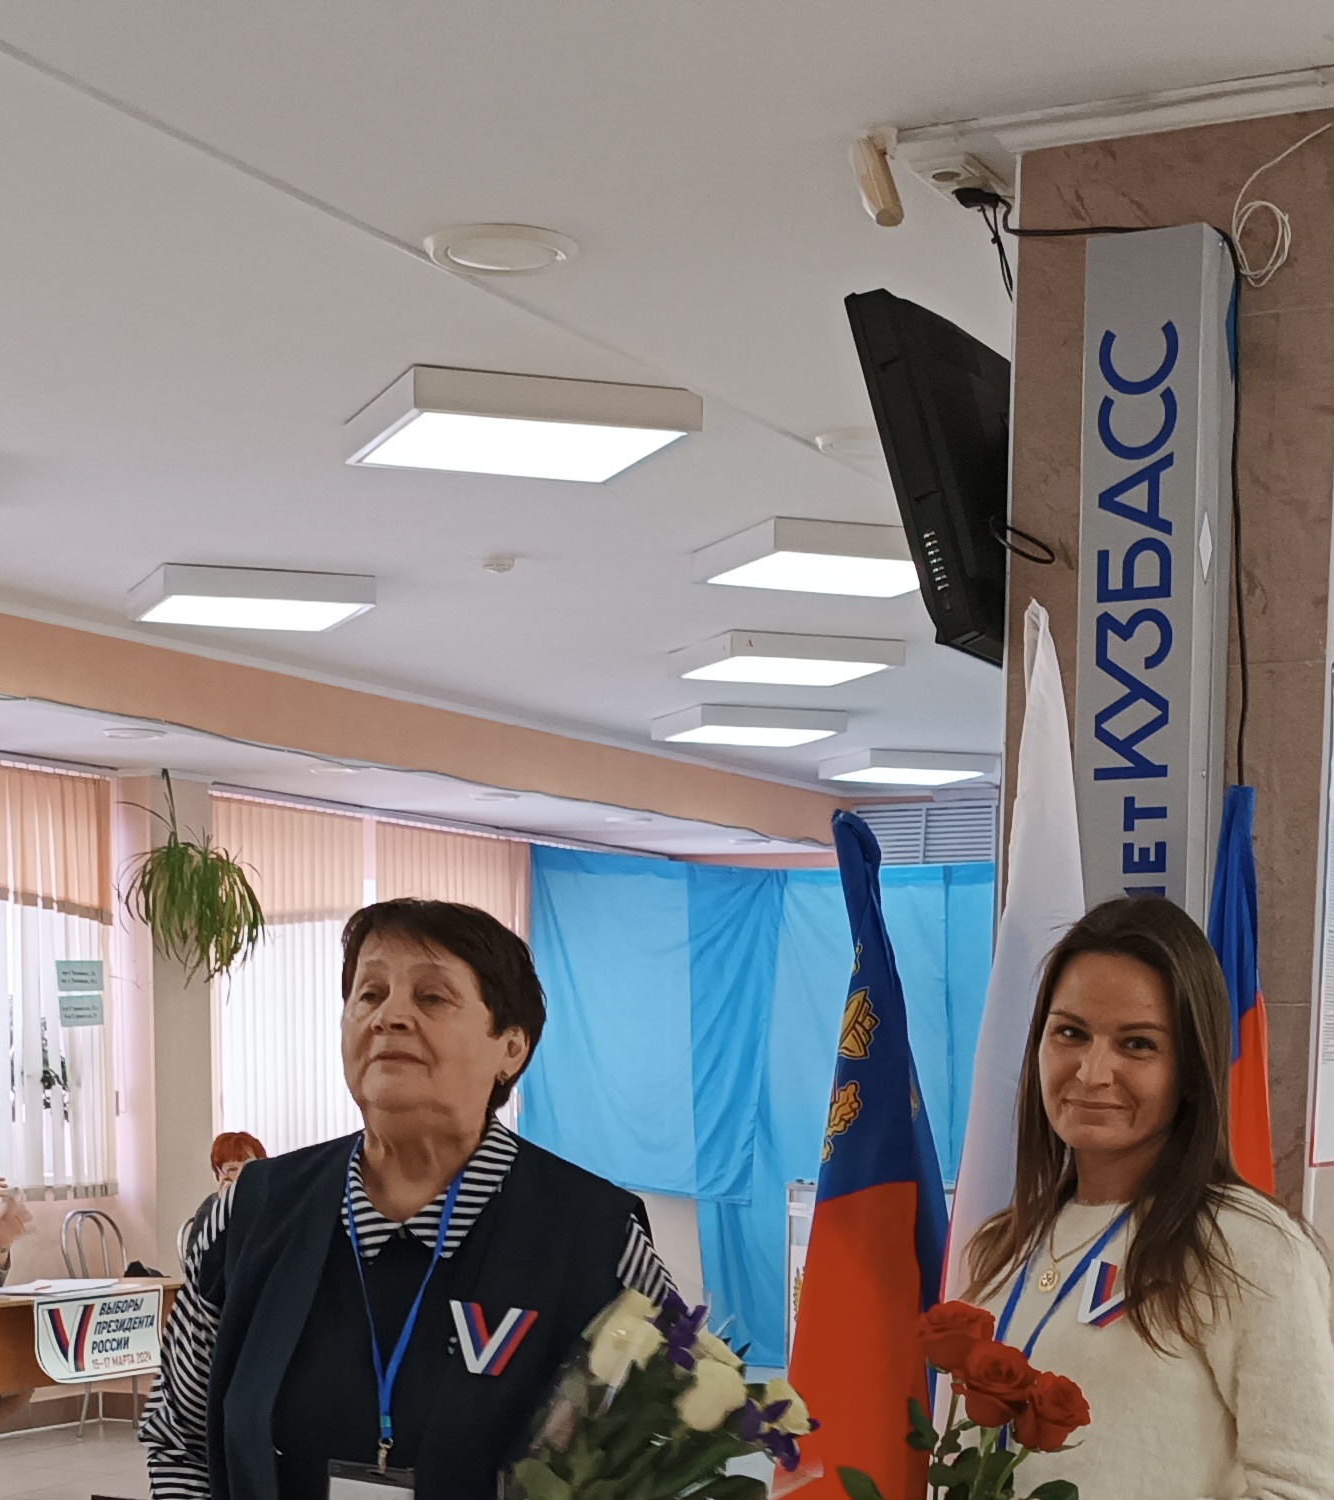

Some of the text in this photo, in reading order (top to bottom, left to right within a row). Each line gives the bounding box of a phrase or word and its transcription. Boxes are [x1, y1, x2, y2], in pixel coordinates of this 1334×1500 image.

[1094, 319, 1178, 780] КУЗБАСС
[1123, 796, 1167, 898] ЕТ
[99, 1298, 144, 1316] ВЫБОРЫ
[94, 1315, 155, 1335] ПРЕЗИДЕНТА
[91, 1336, 130, 1354] РОССИИ
